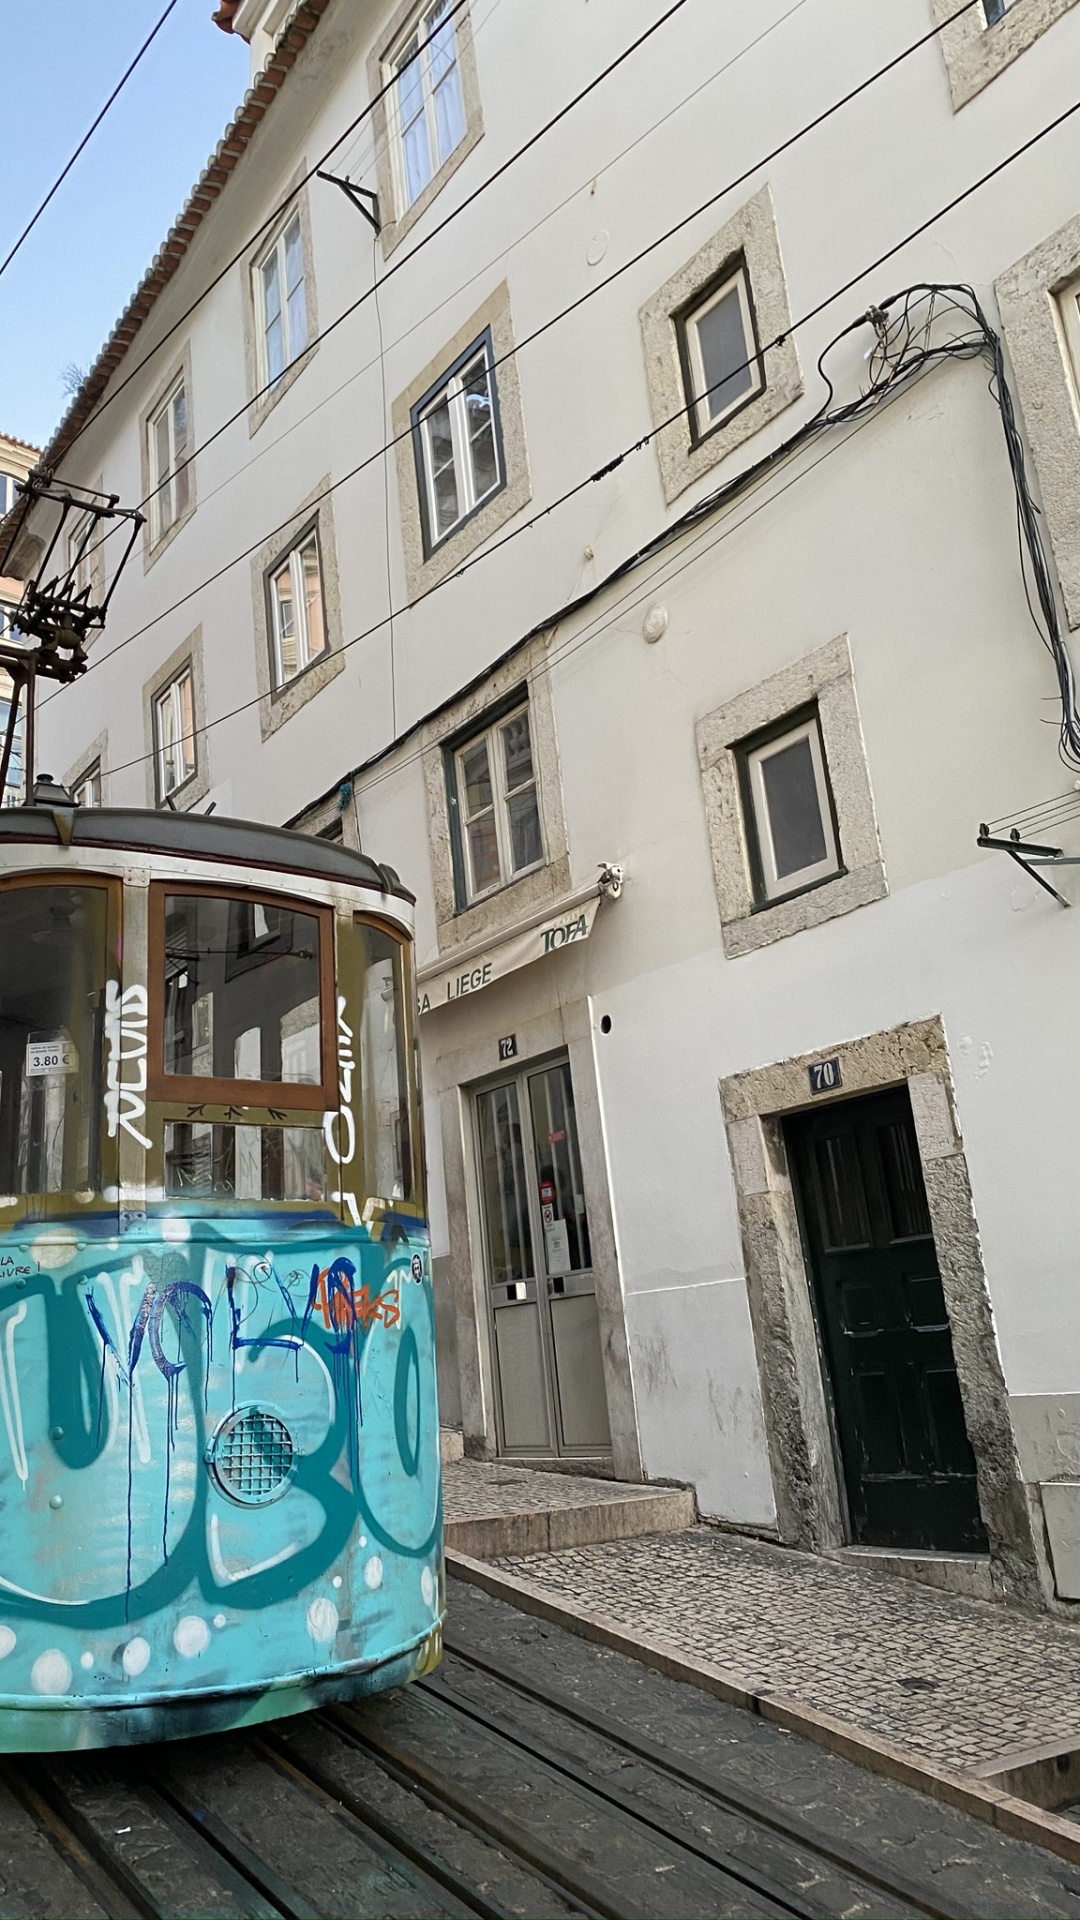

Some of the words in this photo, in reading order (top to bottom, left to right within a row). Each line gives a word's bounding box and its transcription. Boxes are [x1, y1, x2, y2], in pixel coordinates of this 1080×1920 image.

[540, 914, 589, 953] TOFA
[447, 962, 493, 1000] LIEGE
[33, 1055, 59, 1067] 3.80
[62, 1054, 70, 1065] €
[500, 1038, 514, 1058] 72
[813, 1062, 835, 1089] 70
